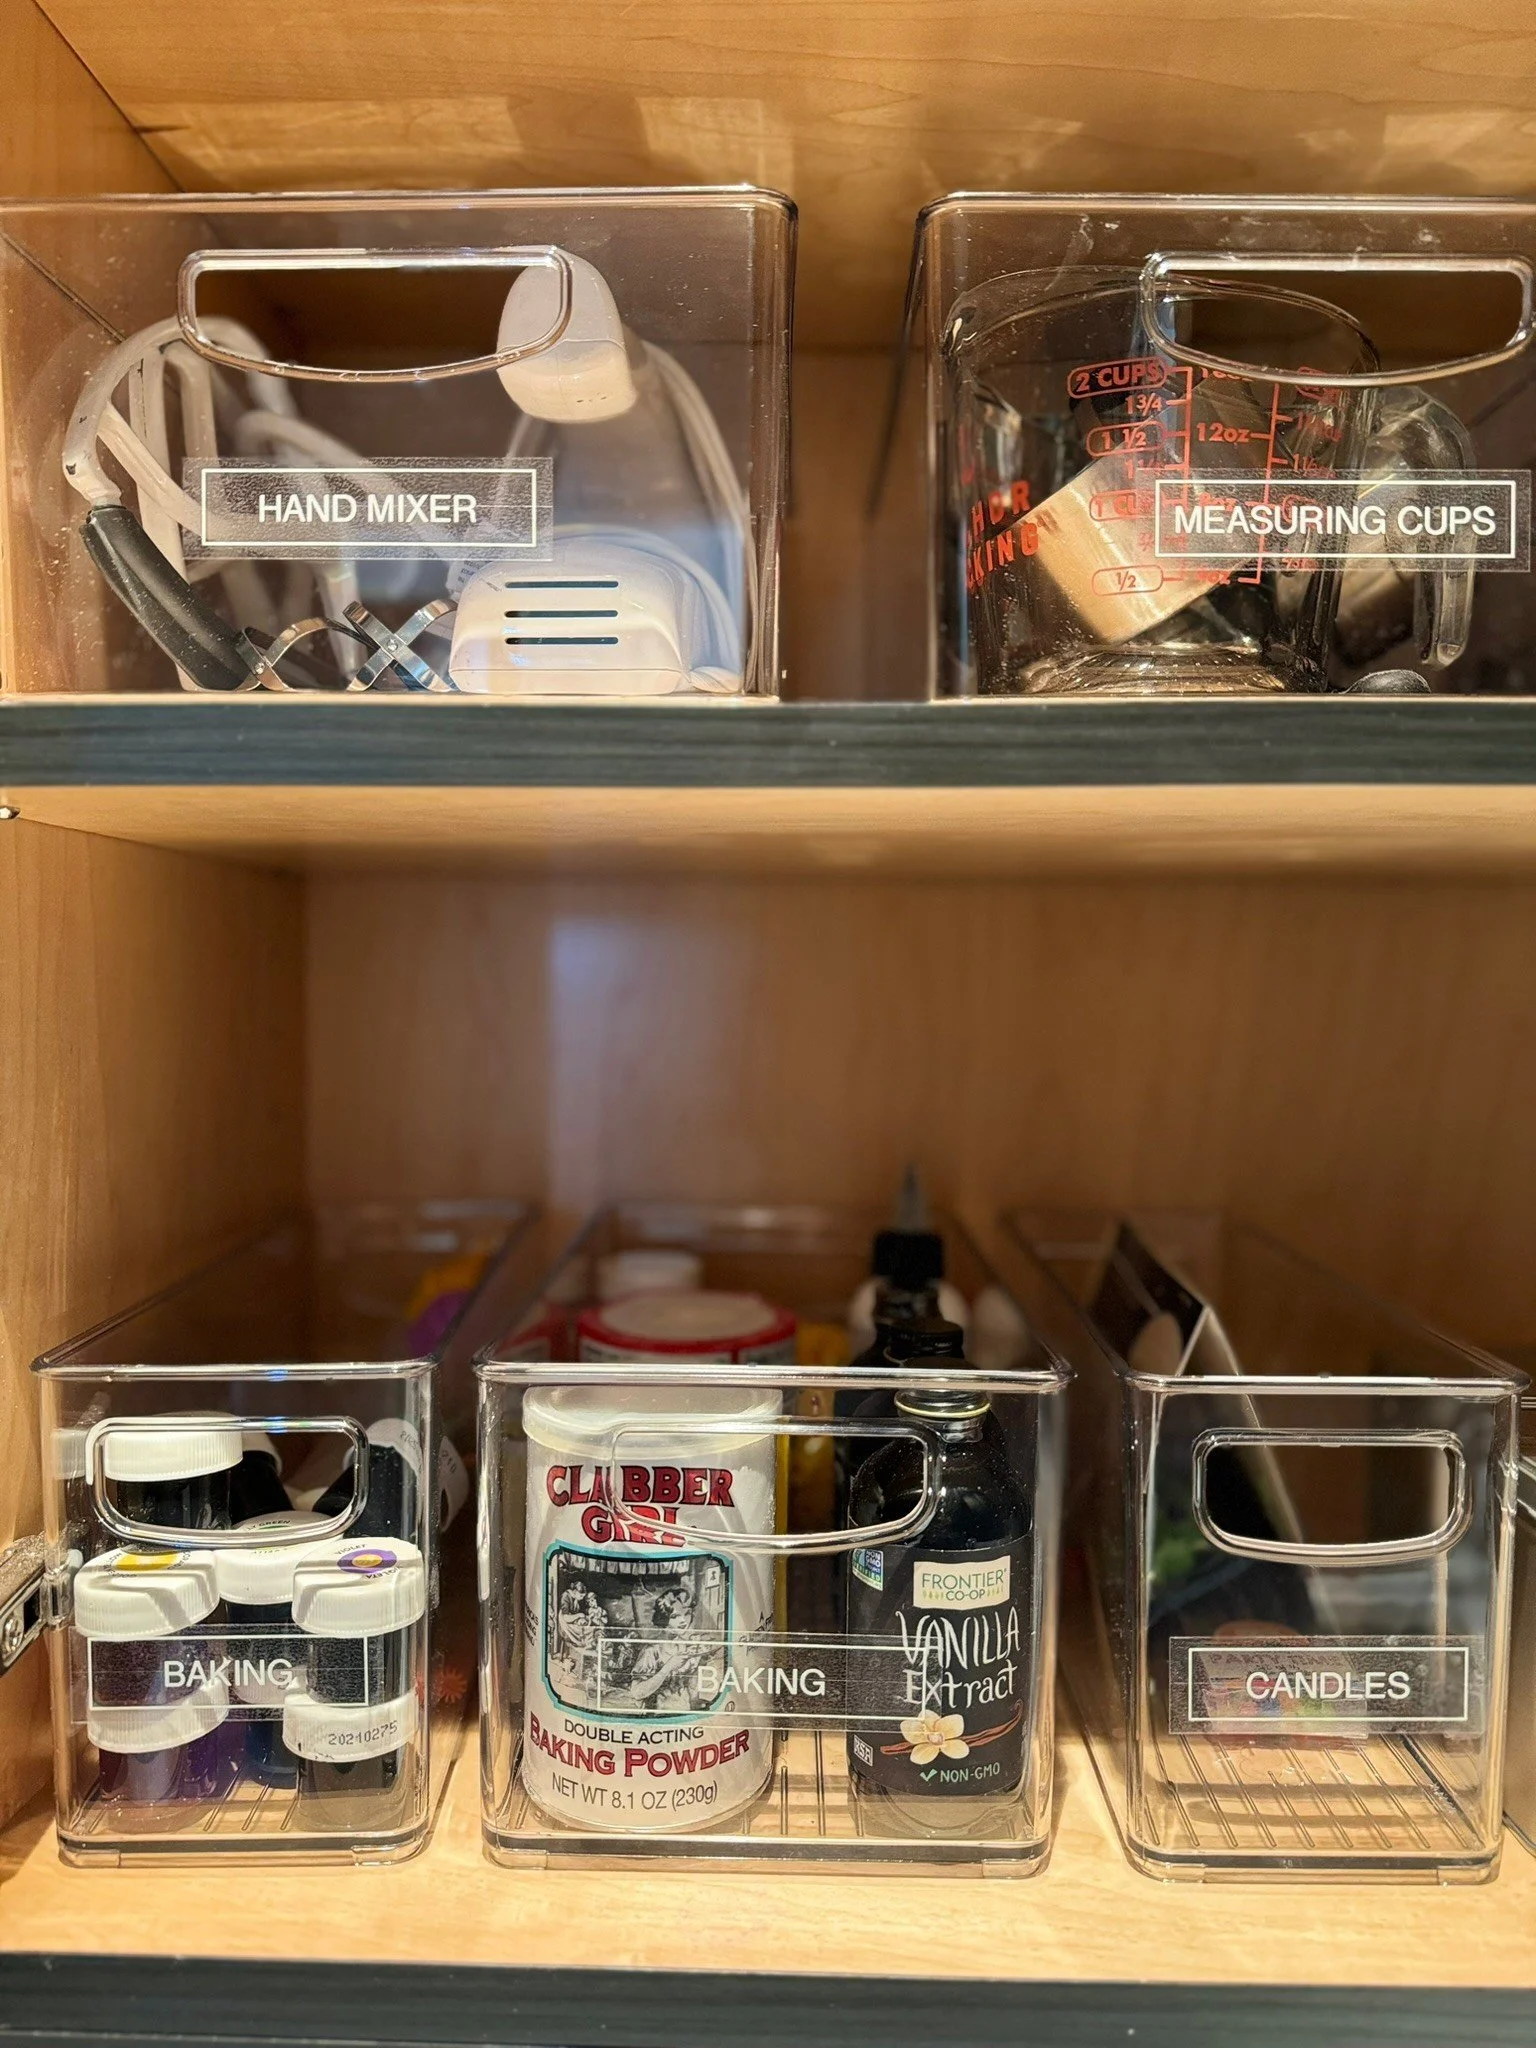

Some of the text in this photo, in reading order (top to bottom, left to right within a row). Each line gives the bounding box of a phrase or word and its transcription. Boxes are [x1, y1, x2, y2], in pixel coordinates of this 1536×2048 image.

[1075, 360, 1160, 392] 2 CUPS
[1196, 422, 1250, 443] 12oz
[258, 493, 478, 523] HAND MIXER
[1174, 505, 1497, 536] MEASURING CUPS
[546, 1464, 735, 1507] CLABBER
[922, 1569, 1005, 1590] FRONTIER
[946, 1588, 986, 1601] CO-OP
[895, 1606, 1021, 1670] VANILLA
[164, 1659, 294, 1688] BAKING
[698, 1665, 826, 1697] BAKING
[902, 1659, 1018, 1709] Extract
[1246, 1671, 1411, 1700] CANDLES
[328, 1720, 398, 1746] 20210275
[530, 1711, 750, 1778] BAKING POWDER
[564, 1718, 704, 1745] DOUBLE ACTING
[939, 1762, 1001, 1783] NON-GMO
[552, 1771, 718, 1812] NET WT 8.1 OZ (230g)
